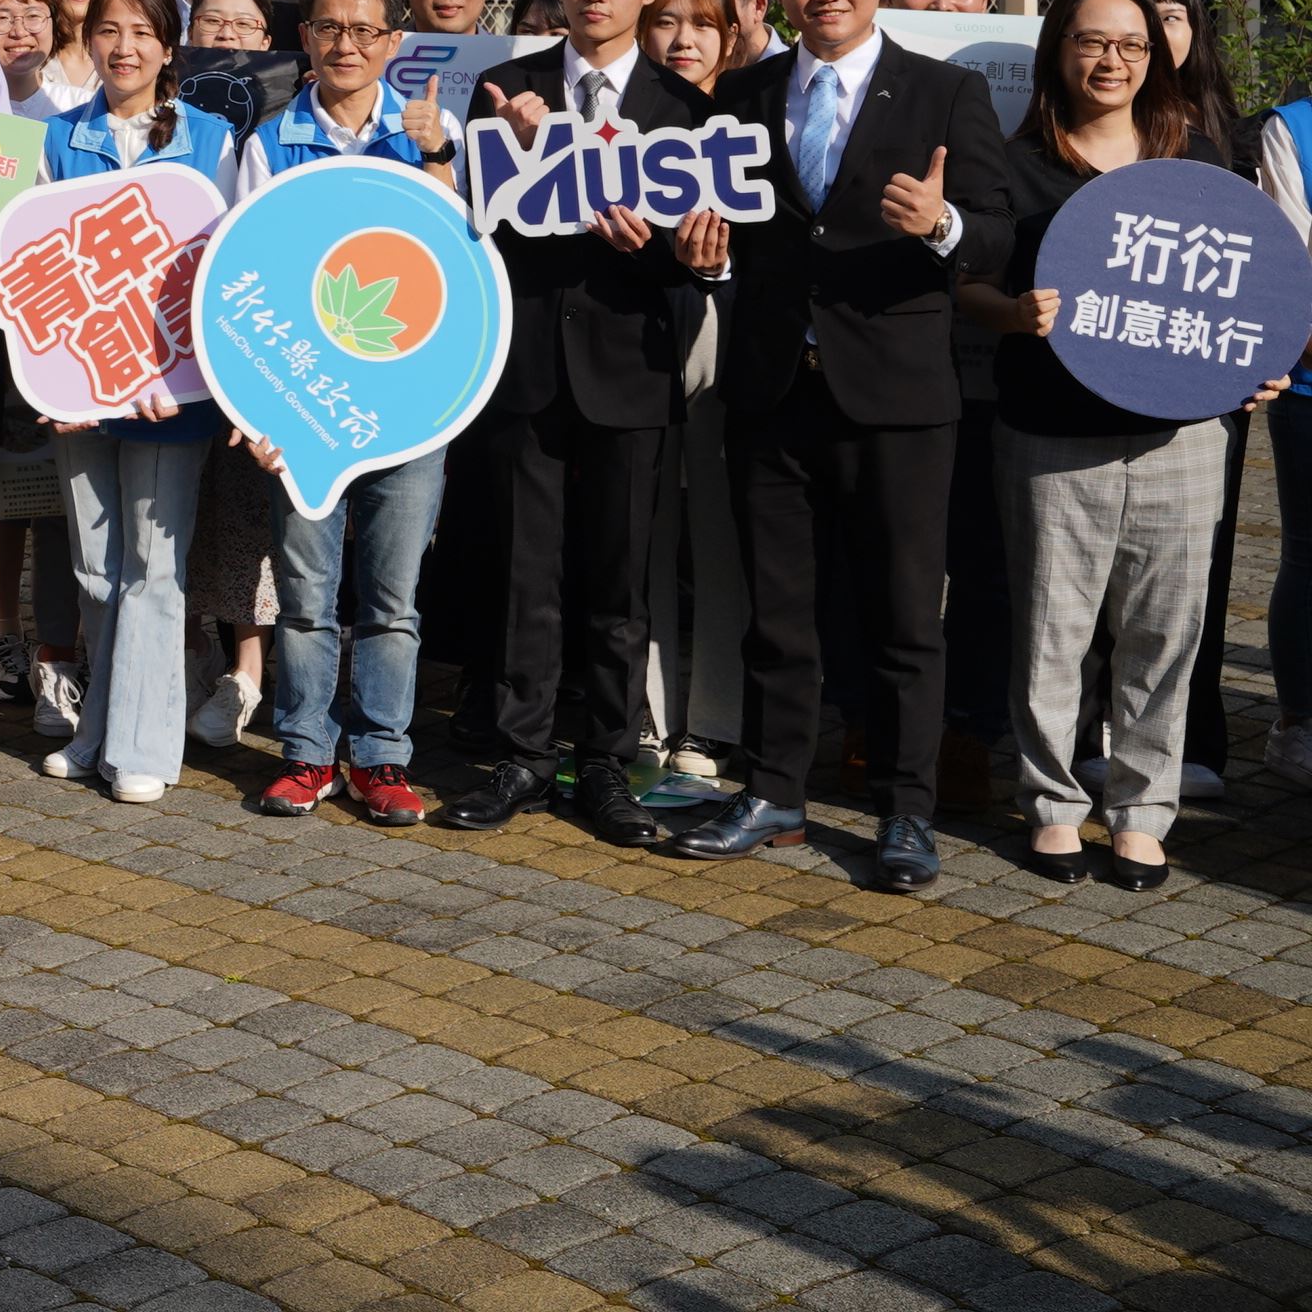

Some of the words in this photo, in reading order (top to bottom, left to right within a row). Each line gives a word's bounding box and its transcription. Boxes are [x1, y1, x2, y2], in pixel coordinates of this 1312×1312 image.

[1105, 211, 1253, 299] 珩衍
[216, 315, 255, 361] HsinChu
[253, 356, 287, 394] County
[284, 390, 339, 451] Government
[221, 270, 382, 450] 新竹縣政府
[1069, 289, 1264, 368] 創意執行
